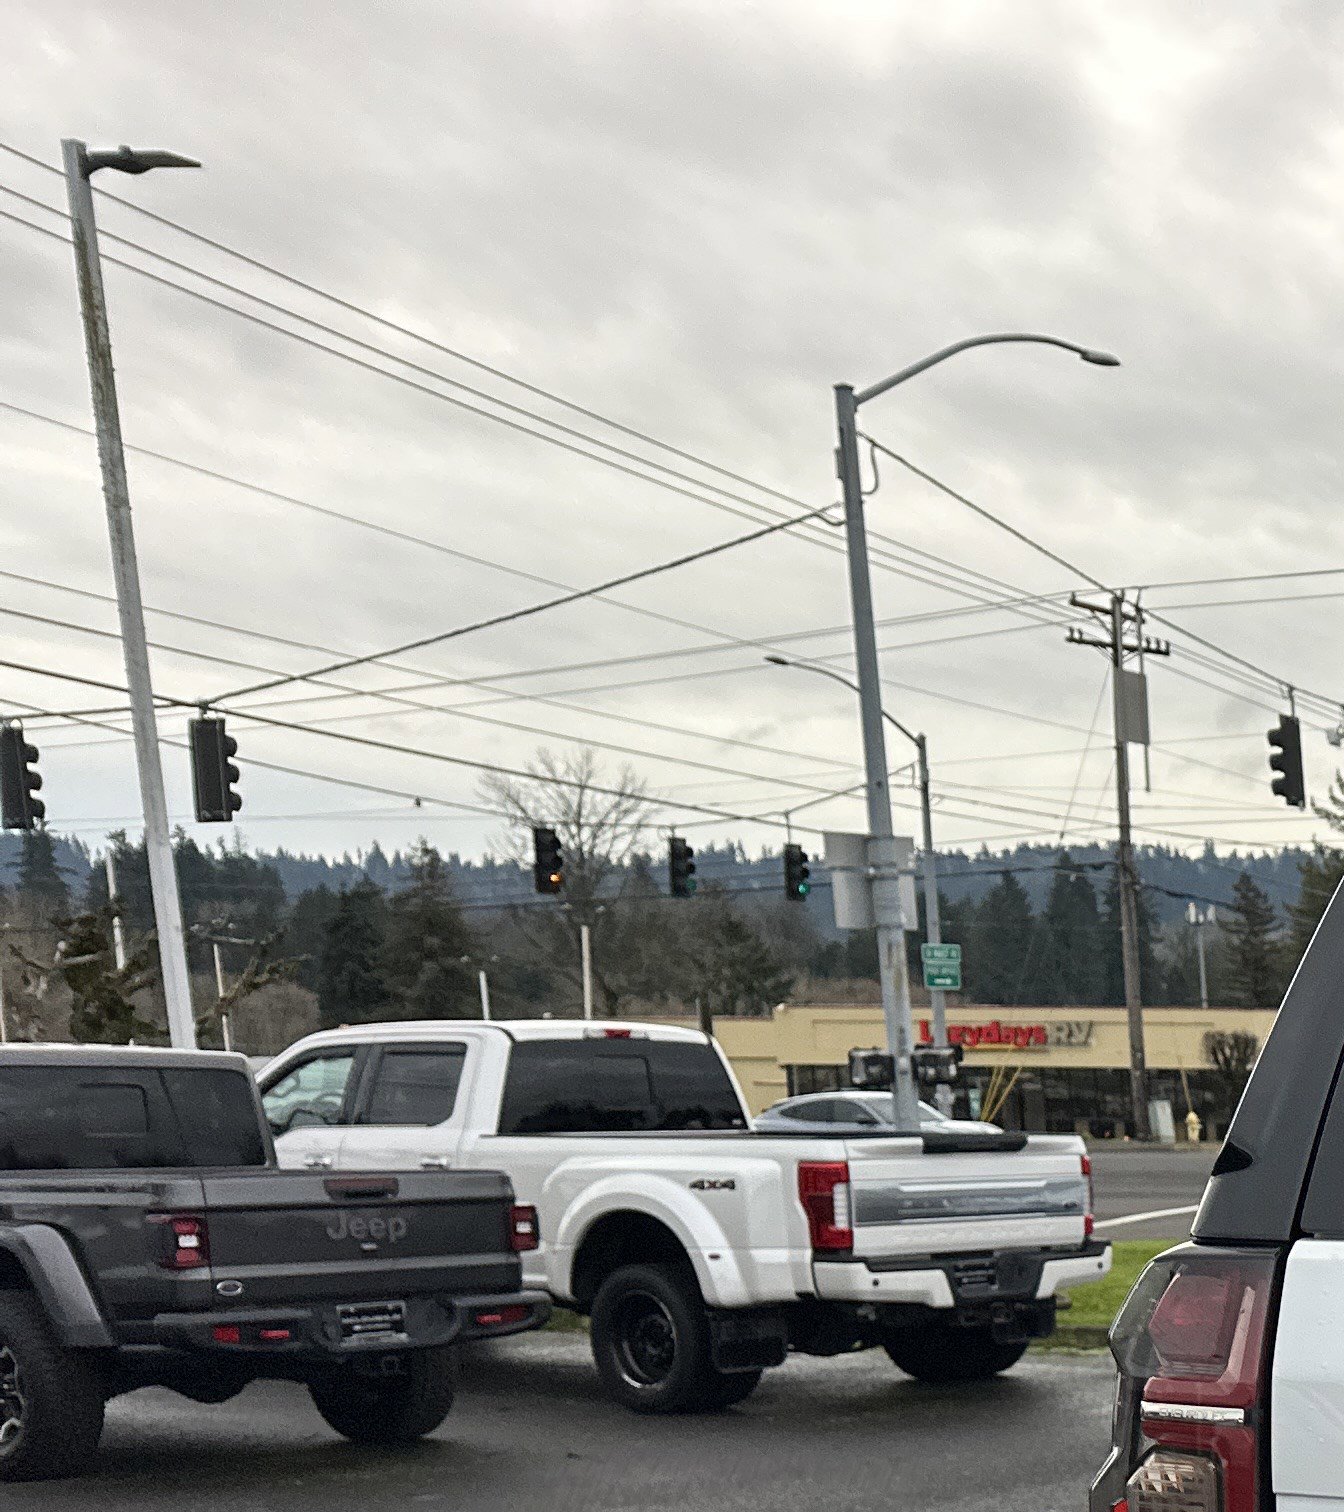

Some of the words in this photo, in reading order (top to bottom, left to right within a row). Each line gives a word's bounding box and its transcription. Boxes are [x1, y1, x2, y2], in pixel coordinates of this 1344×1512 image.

[918, 1019, 1048, 1047] Lzydays
[1049, 1021, 1096, 1047] RV
[326, 1209, 408, 1243] Jeep
